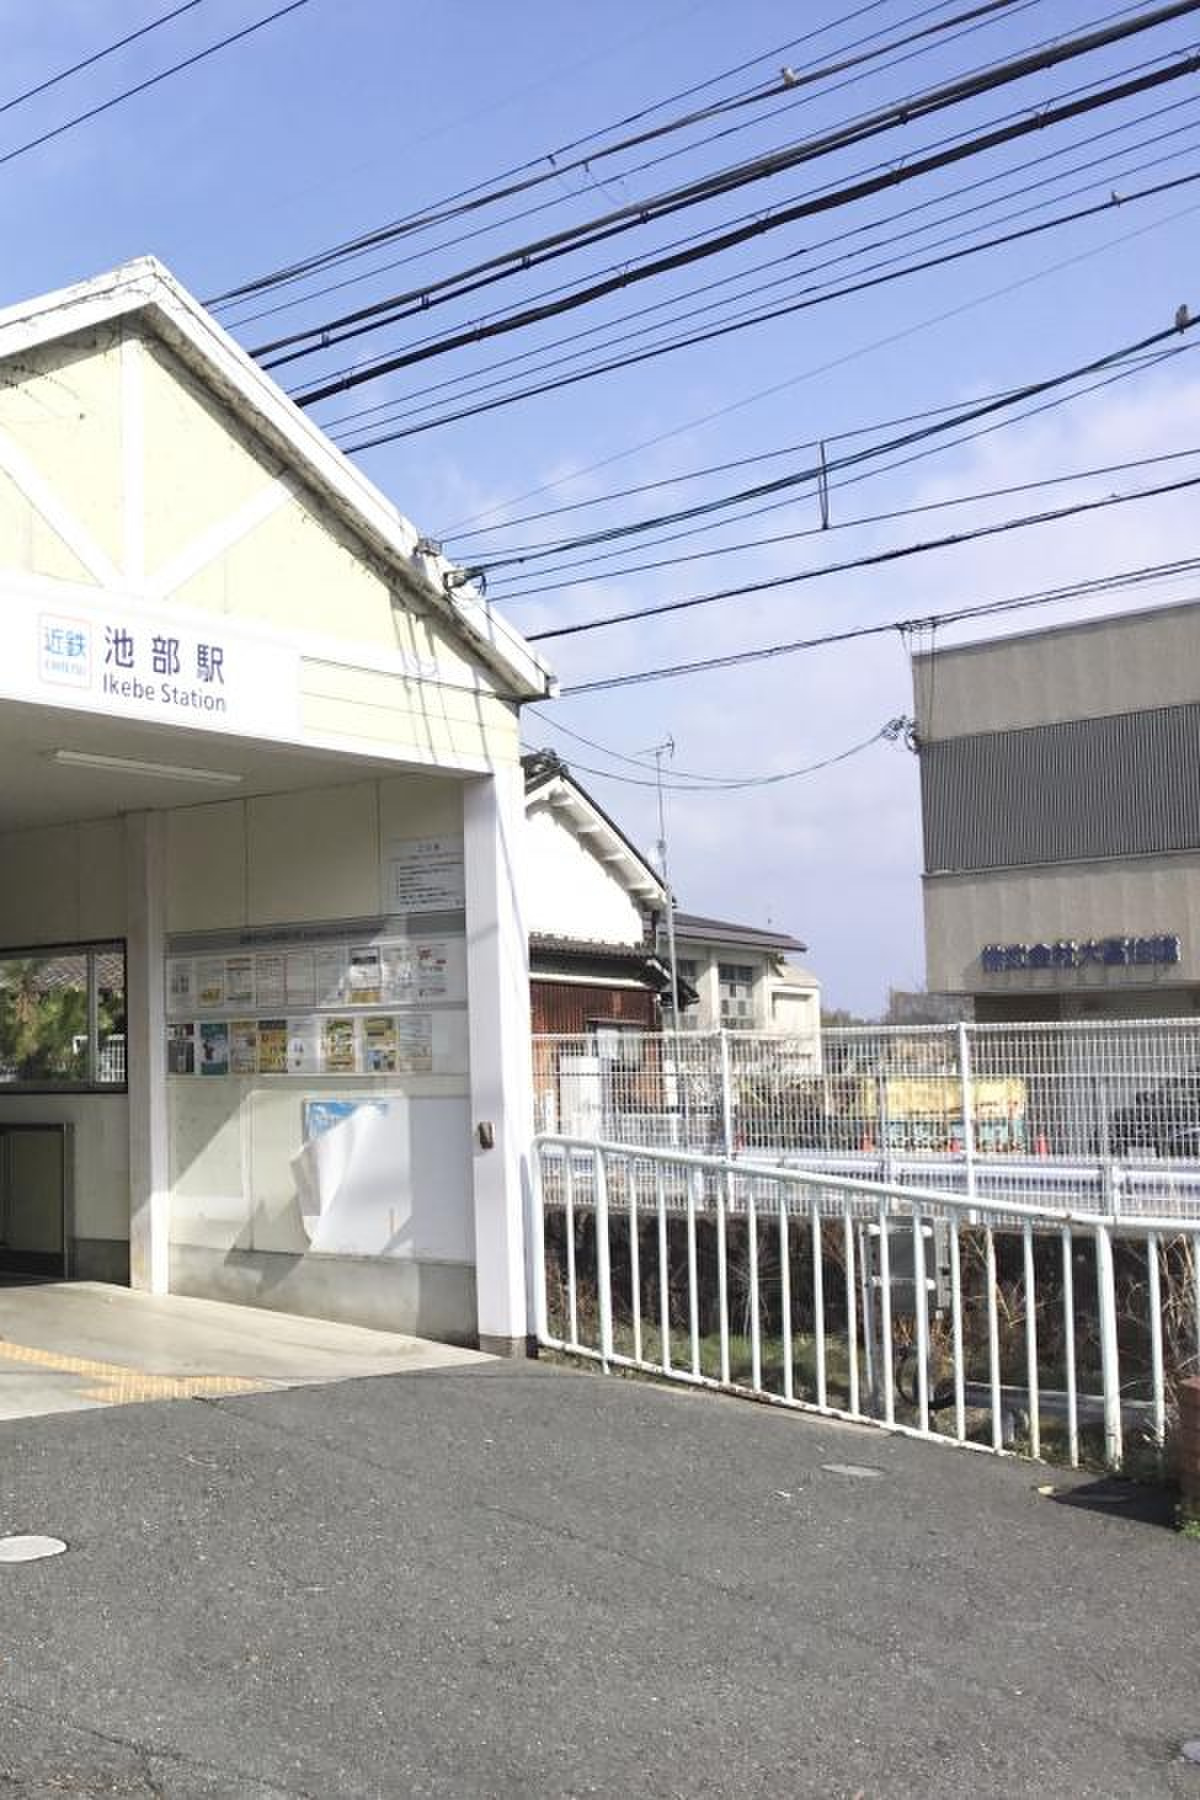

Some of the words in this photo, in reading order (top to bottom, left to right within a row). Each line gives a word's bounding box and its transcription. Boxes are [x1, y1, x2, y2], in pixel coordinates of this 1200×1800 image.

[44, 626, 86, 658] 近鉄
[104, 625, 225, 685] 池部駅
[102, 672, 155, 701] Ikebe
[161, 682, 227, 713] Station
